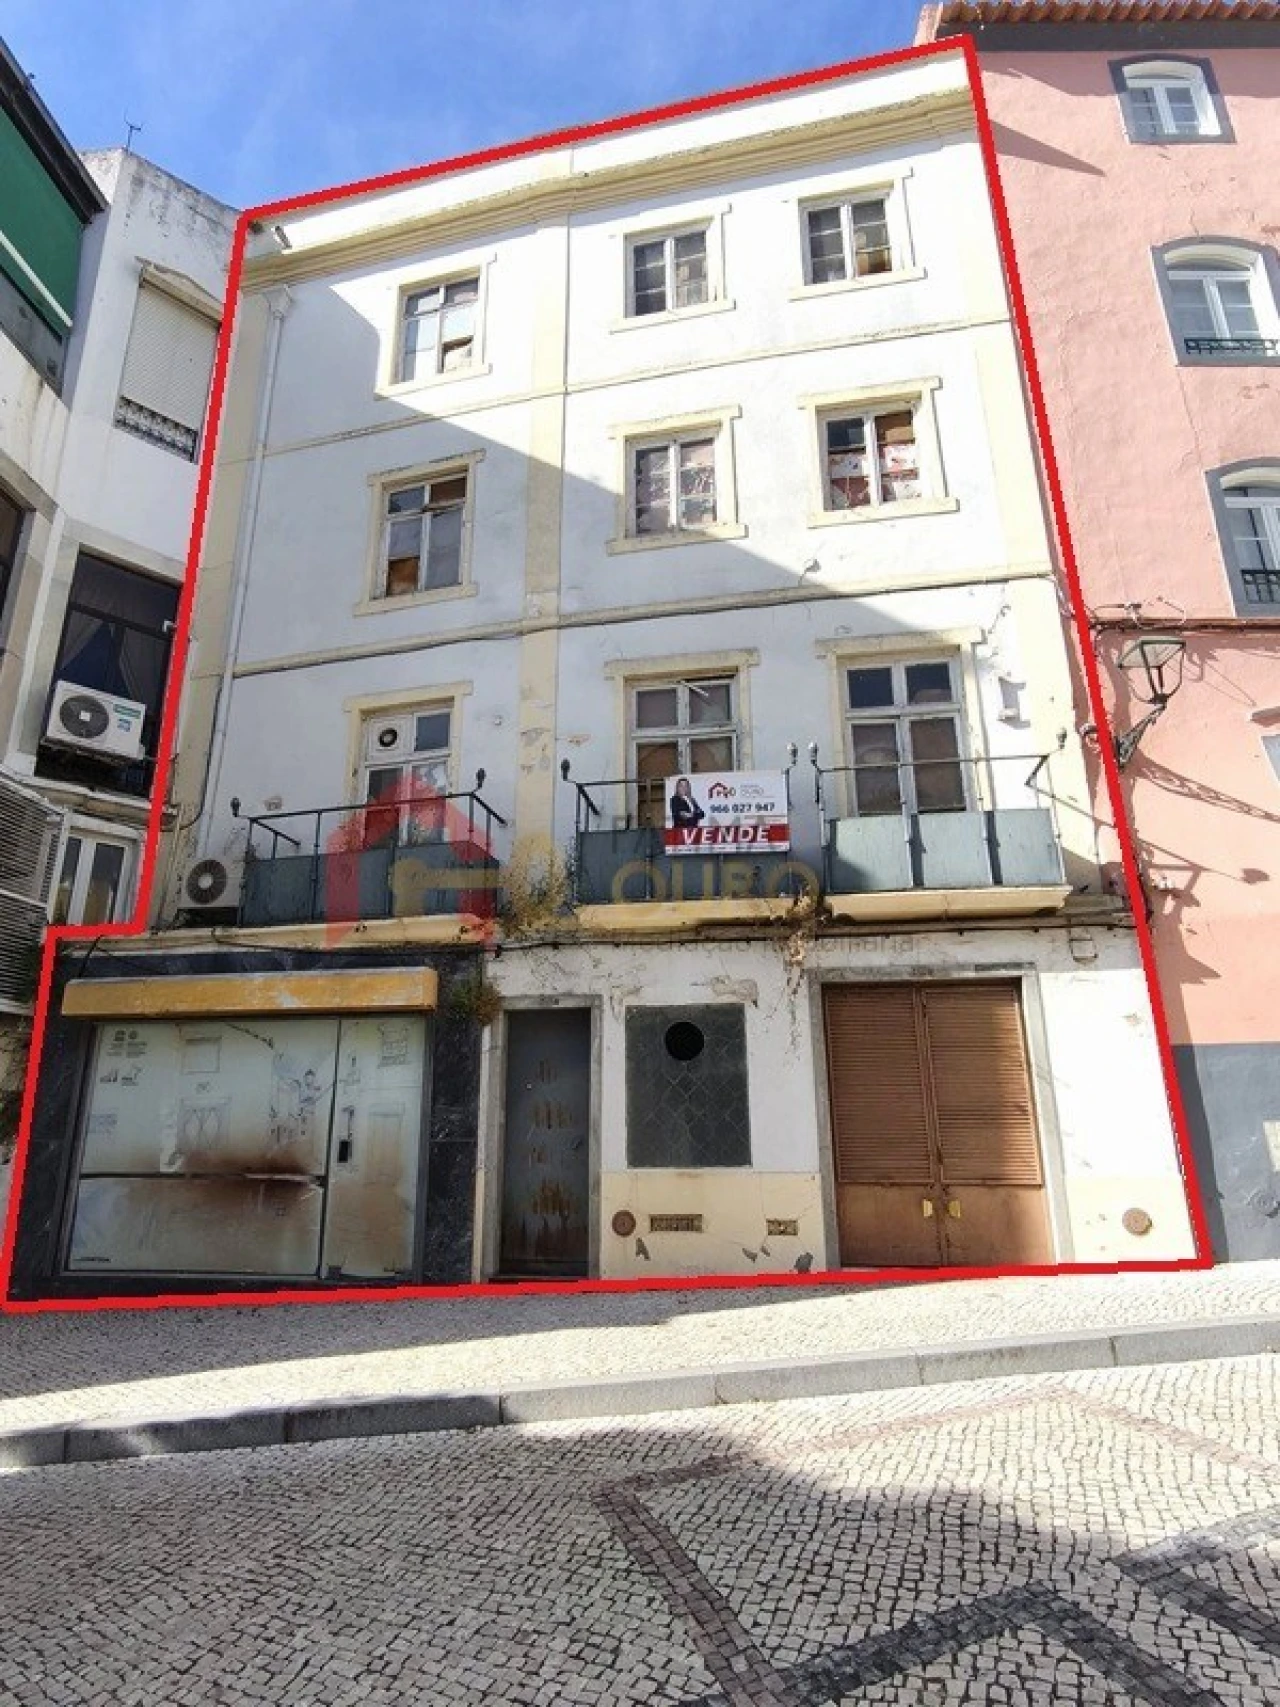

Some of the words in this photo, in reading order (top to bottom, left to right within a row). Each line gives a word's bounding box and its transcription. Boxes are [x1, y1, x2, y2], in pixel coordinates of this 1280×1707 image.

[710, 803, 729, 813] 966
[732, 802, 752, 813] 027
[755, 801, 775, 812] 947
[682, 826, 770, 845] VENDE
